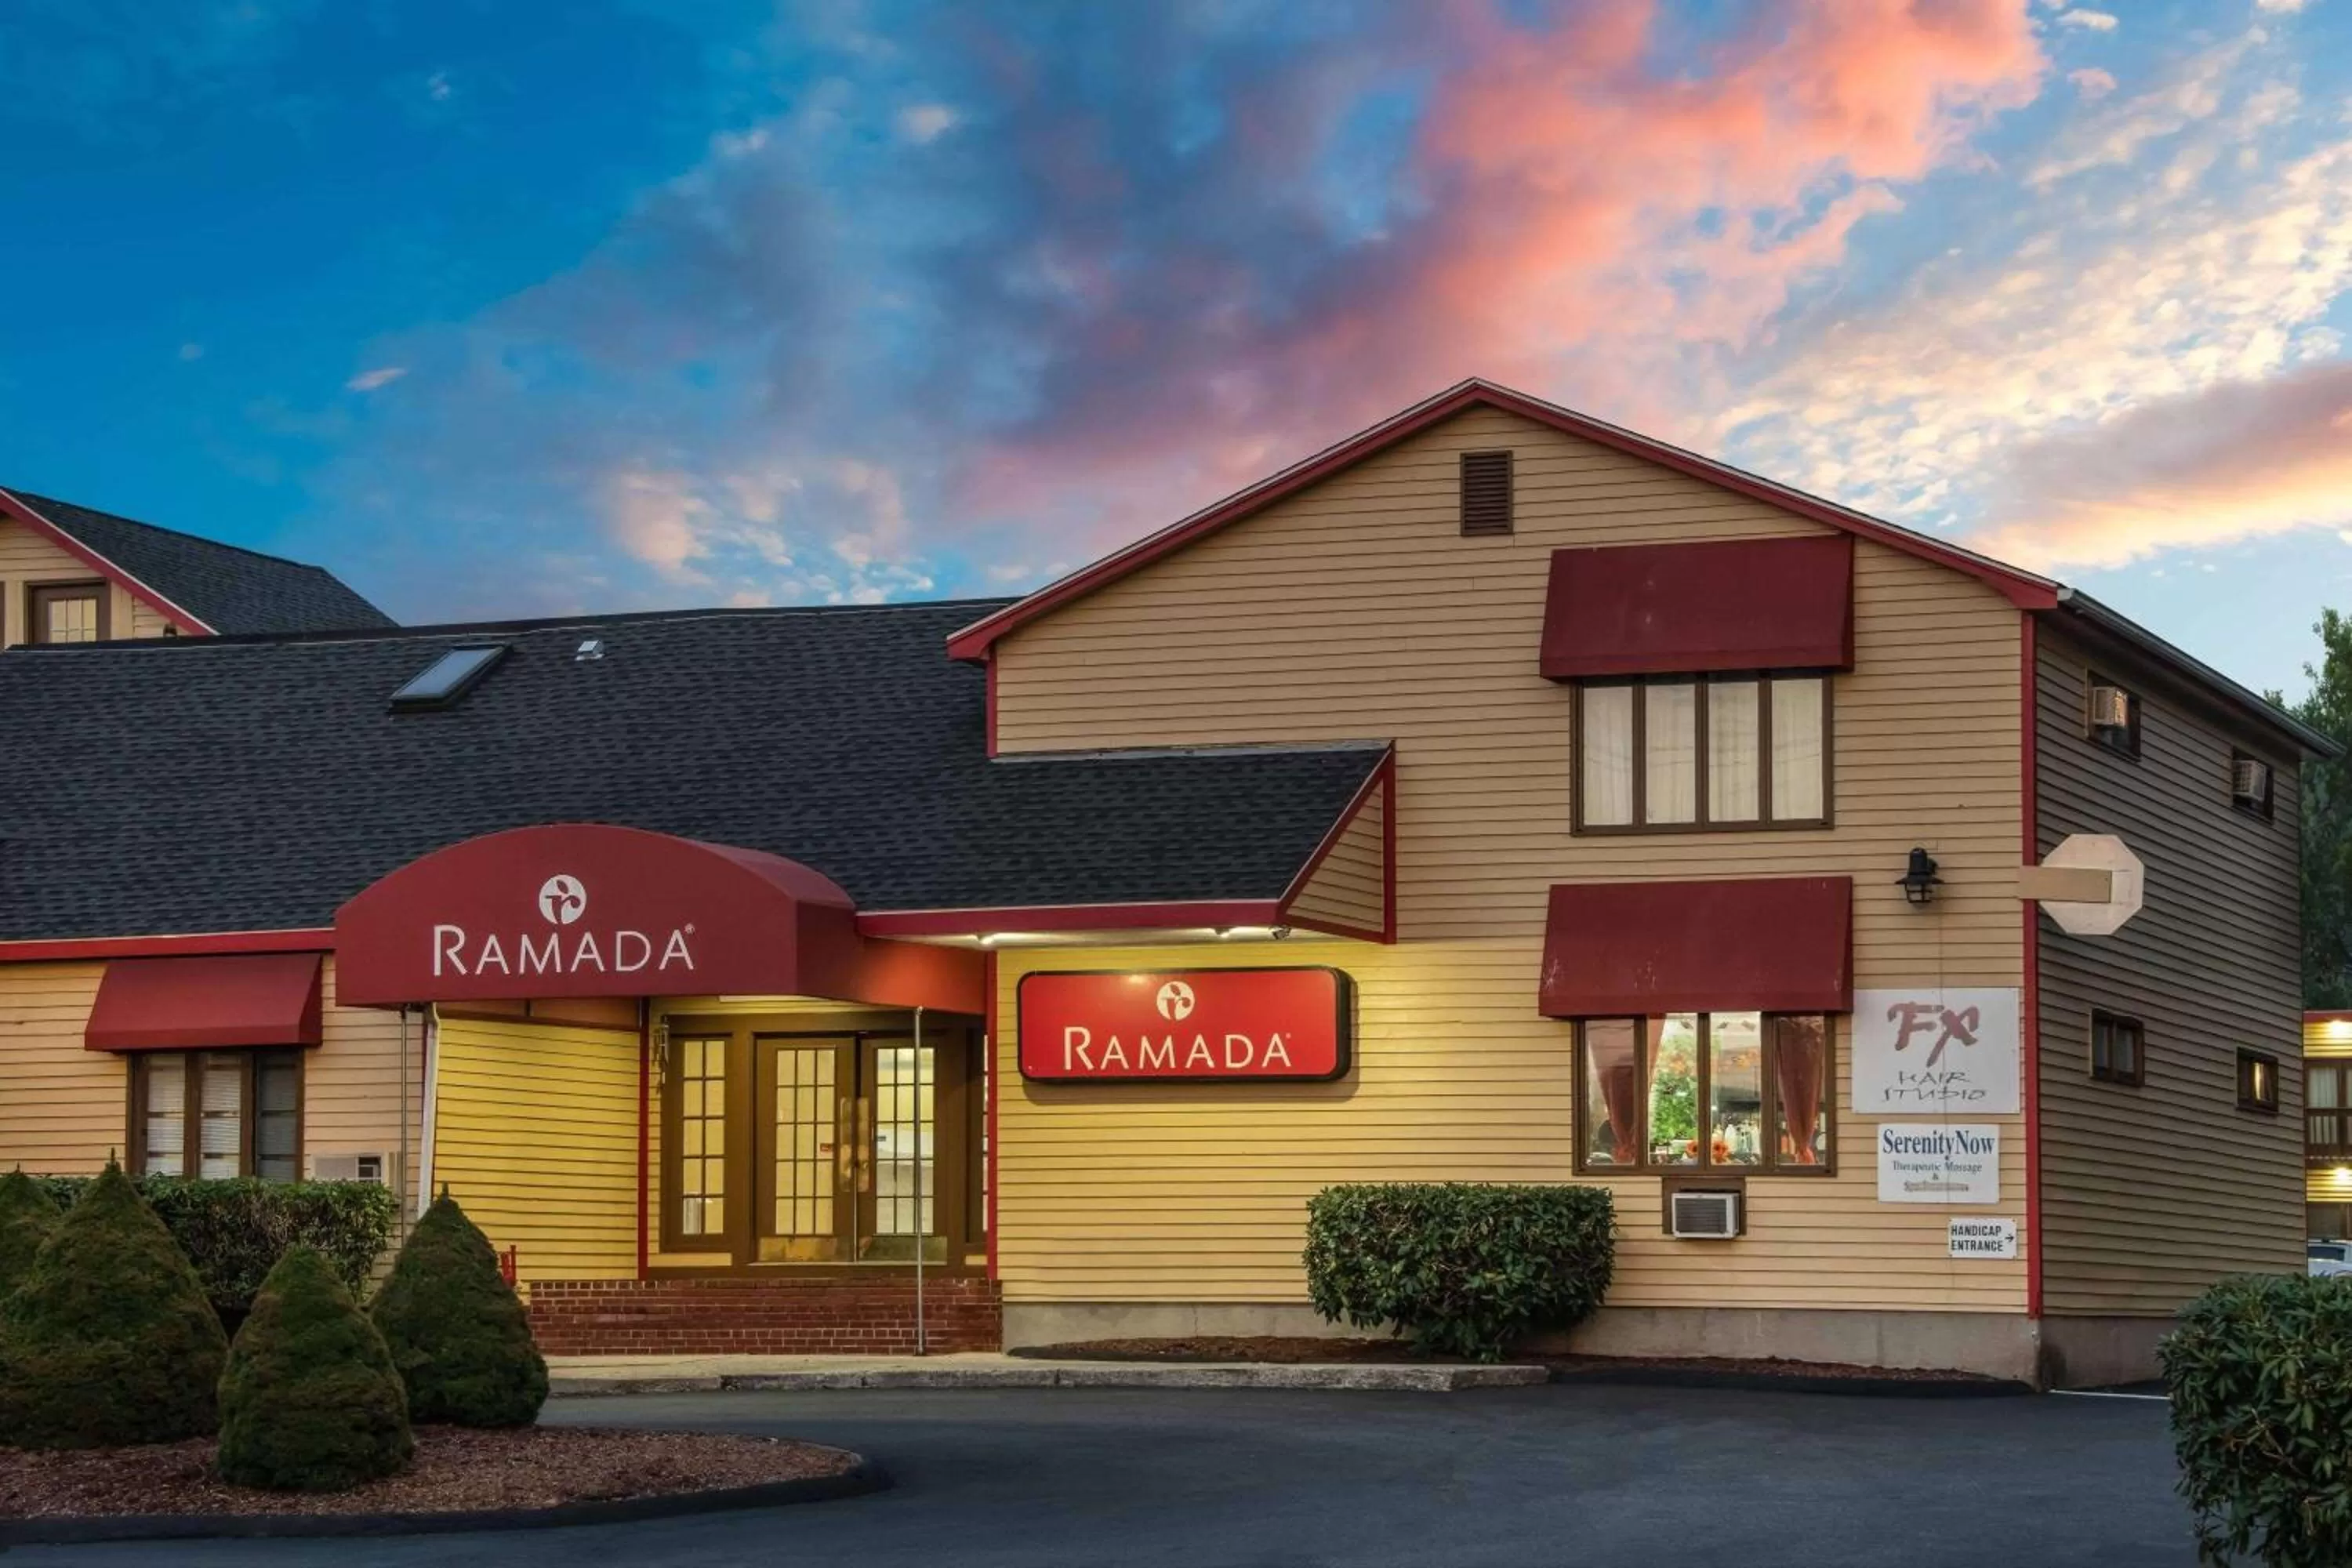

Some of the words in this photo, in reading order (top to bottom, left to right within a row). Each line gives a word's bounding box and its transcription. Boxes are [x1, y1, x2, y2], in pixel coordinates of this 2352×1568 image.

[1899, 1071, 1971, 1085] HAIR
[1882, 1087, 1987, 1101] STUDIO
[1893, 1160, 1941, 1172] Therapeutic
[1944, 1162, 1983, 1174] Massage
[1951, 1225, 2002, 1236] HANDICAP
[1951, 1240, 2004, 1252] ENTRANCE
